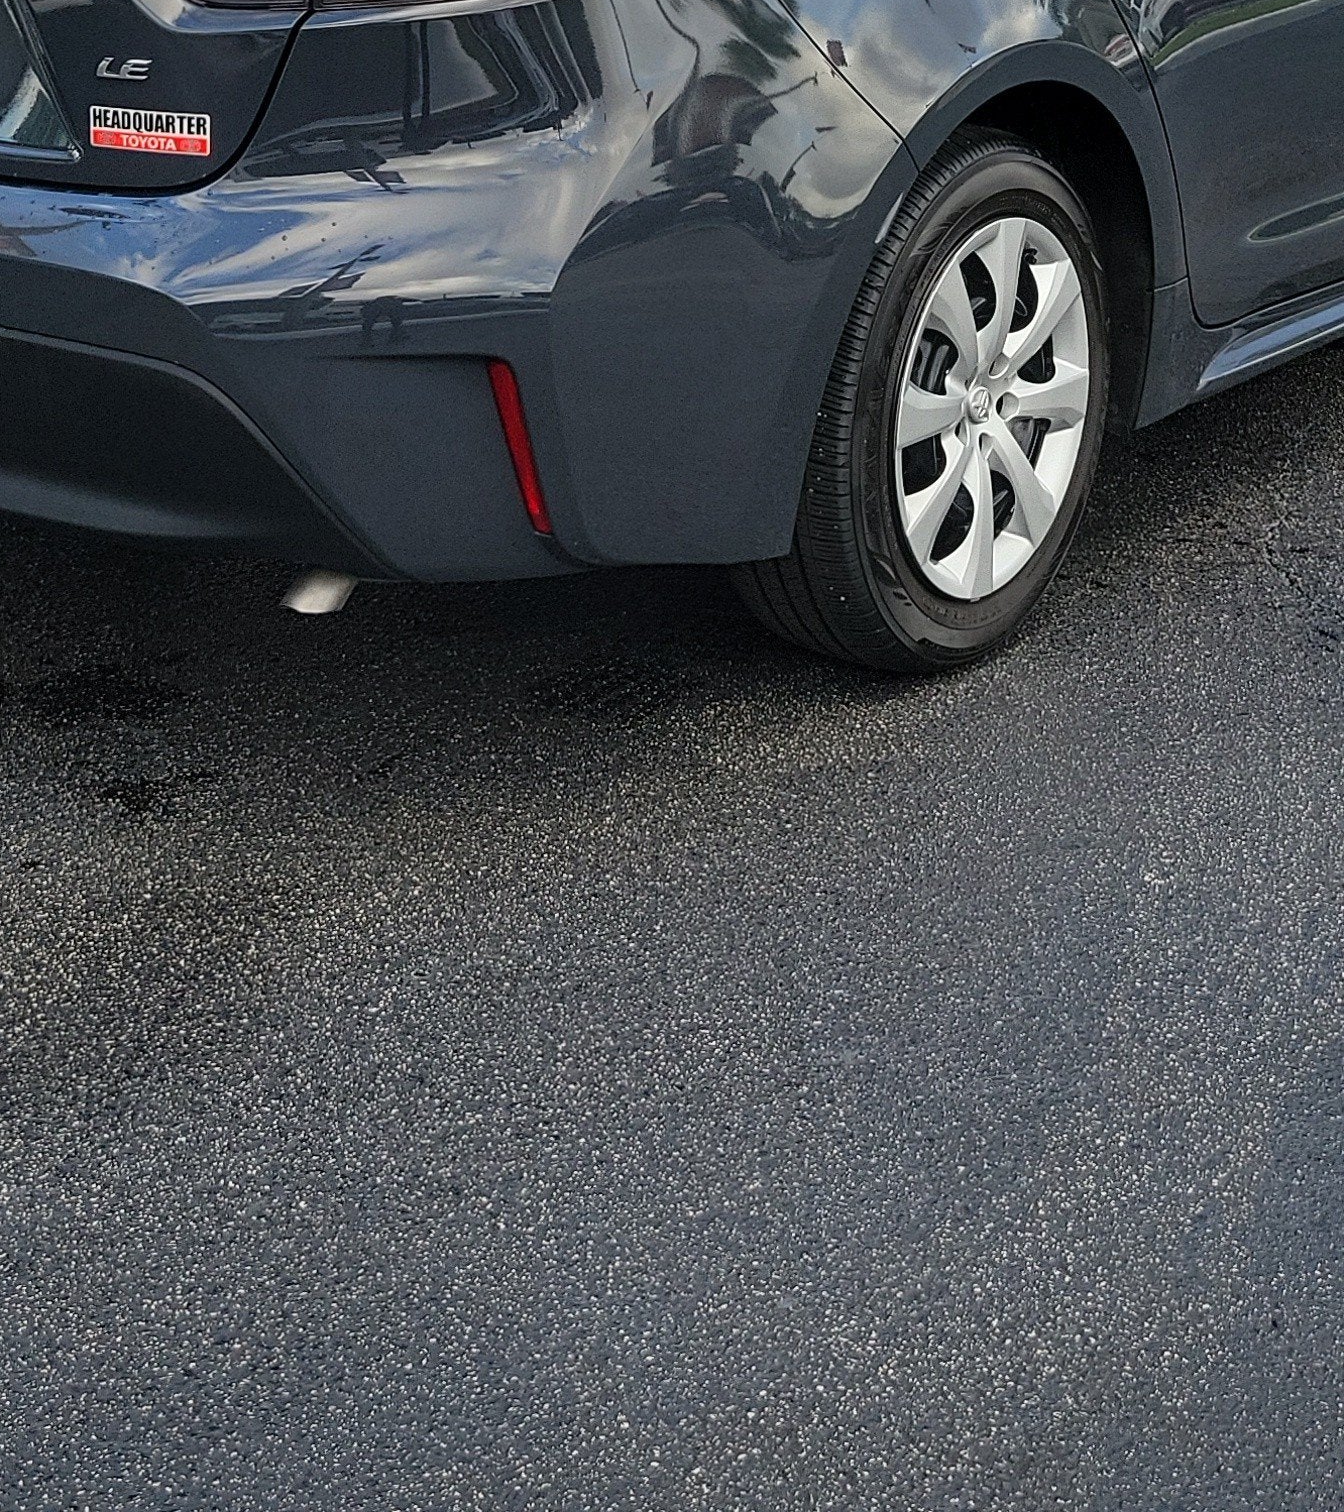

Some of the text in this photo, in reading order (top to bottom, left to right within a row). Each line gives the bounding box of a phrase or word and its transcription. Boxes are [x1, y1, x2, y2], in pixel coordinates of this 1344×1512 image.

[96, 57, 153, 80] LE
[92, 108, 207, 136] HEADQUARTER
[120, 134, 177, 150] TOYOTA
